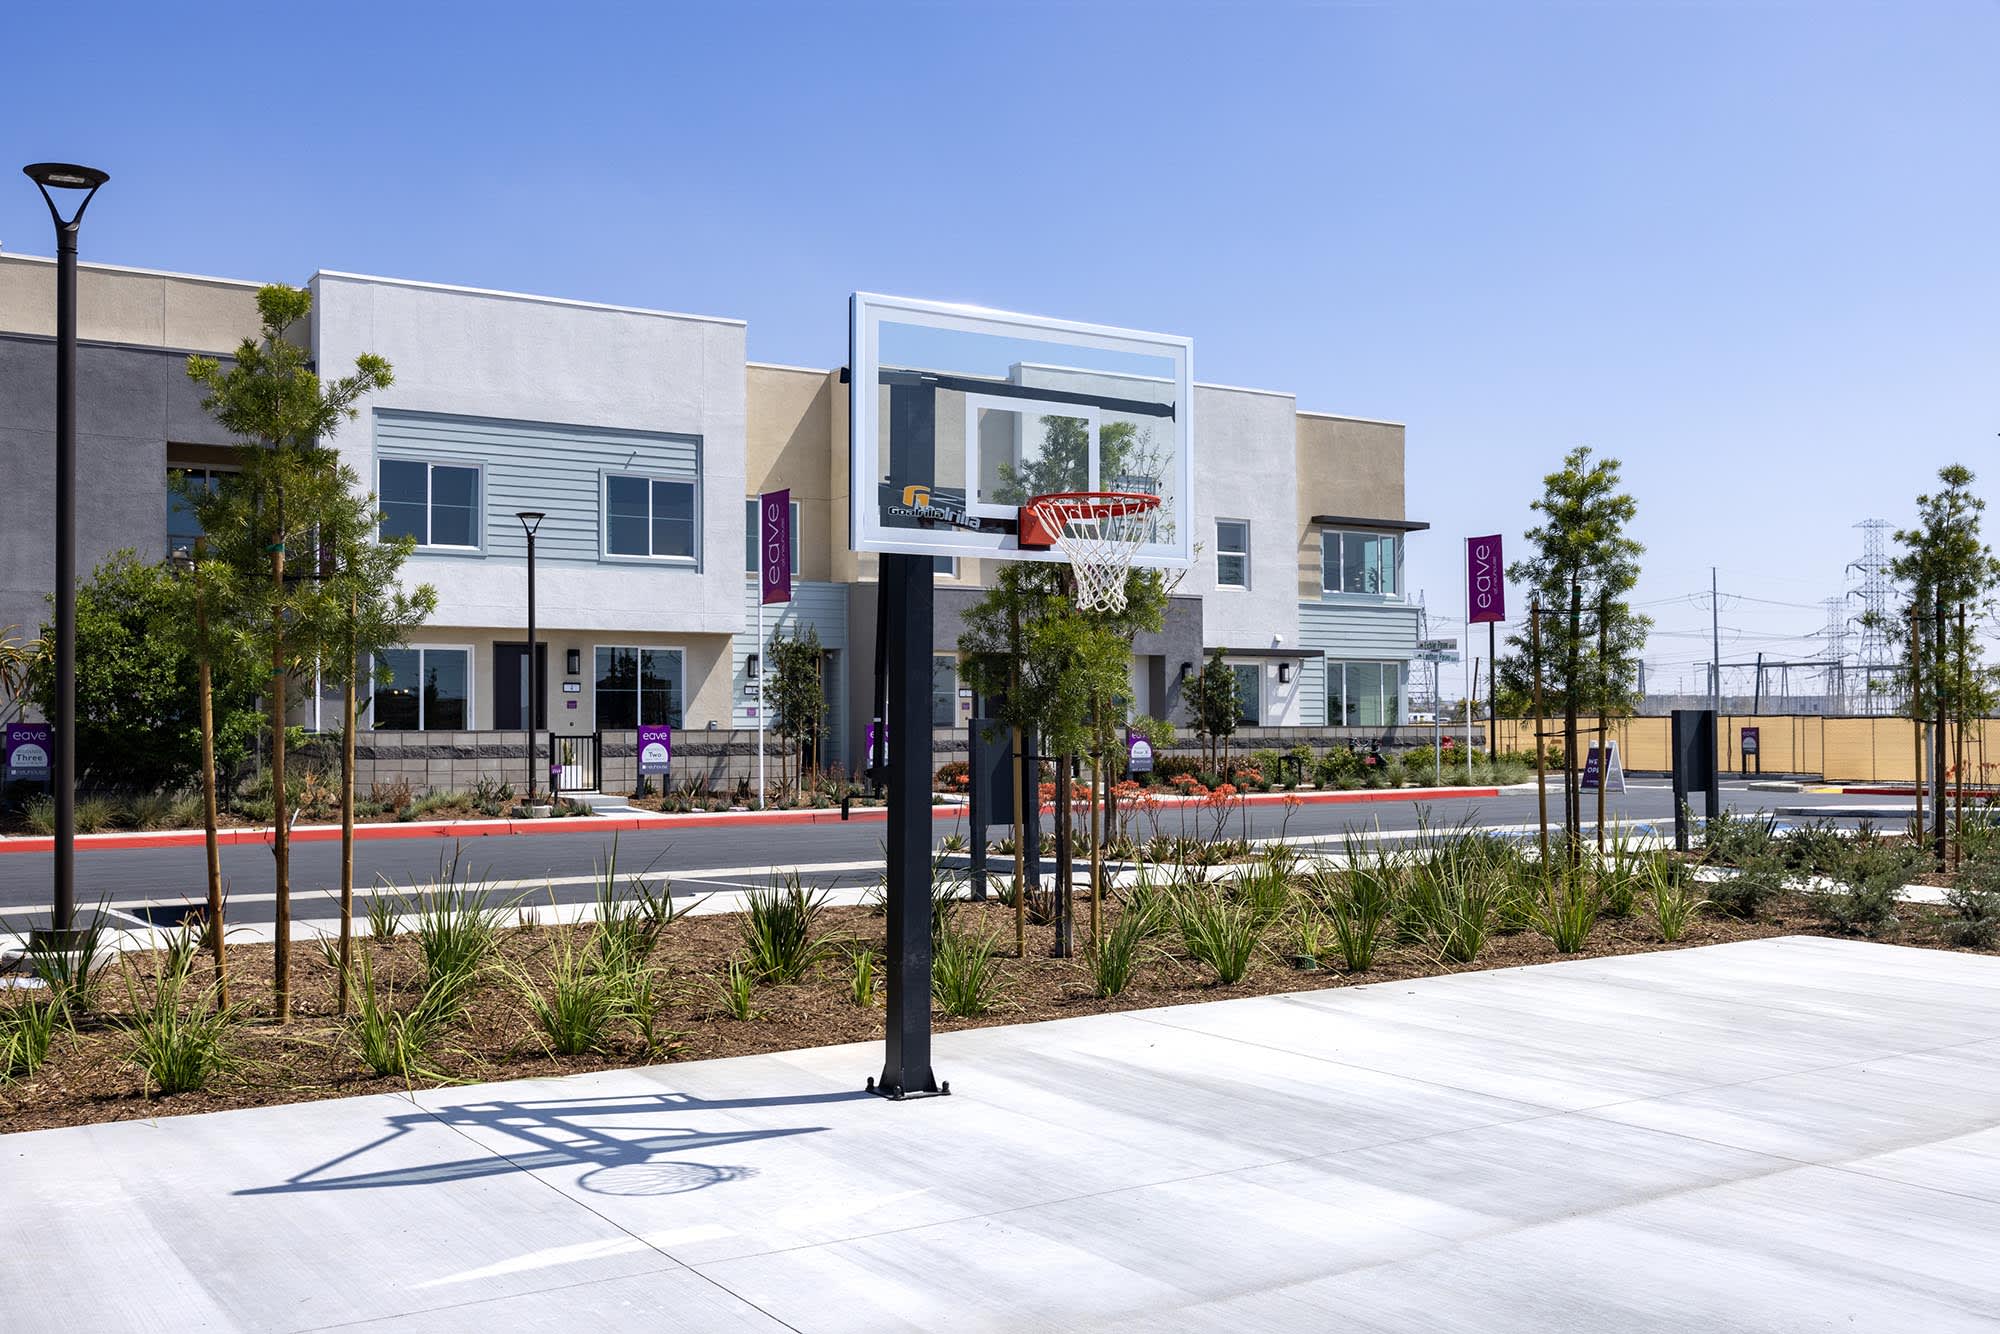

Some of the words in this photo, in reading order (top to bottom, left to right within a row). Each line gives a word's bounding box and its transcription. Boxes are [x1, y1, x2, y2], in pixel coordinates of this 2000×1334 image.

[768, 503, 780, 585] eave
[1476, 544, 1492, 608] eave
[12, 731, 47, 741] eave
[642, 731, 668, 741] eave
[15, 753, 43, 761] Three
[648, 751, 662, 759] Two
